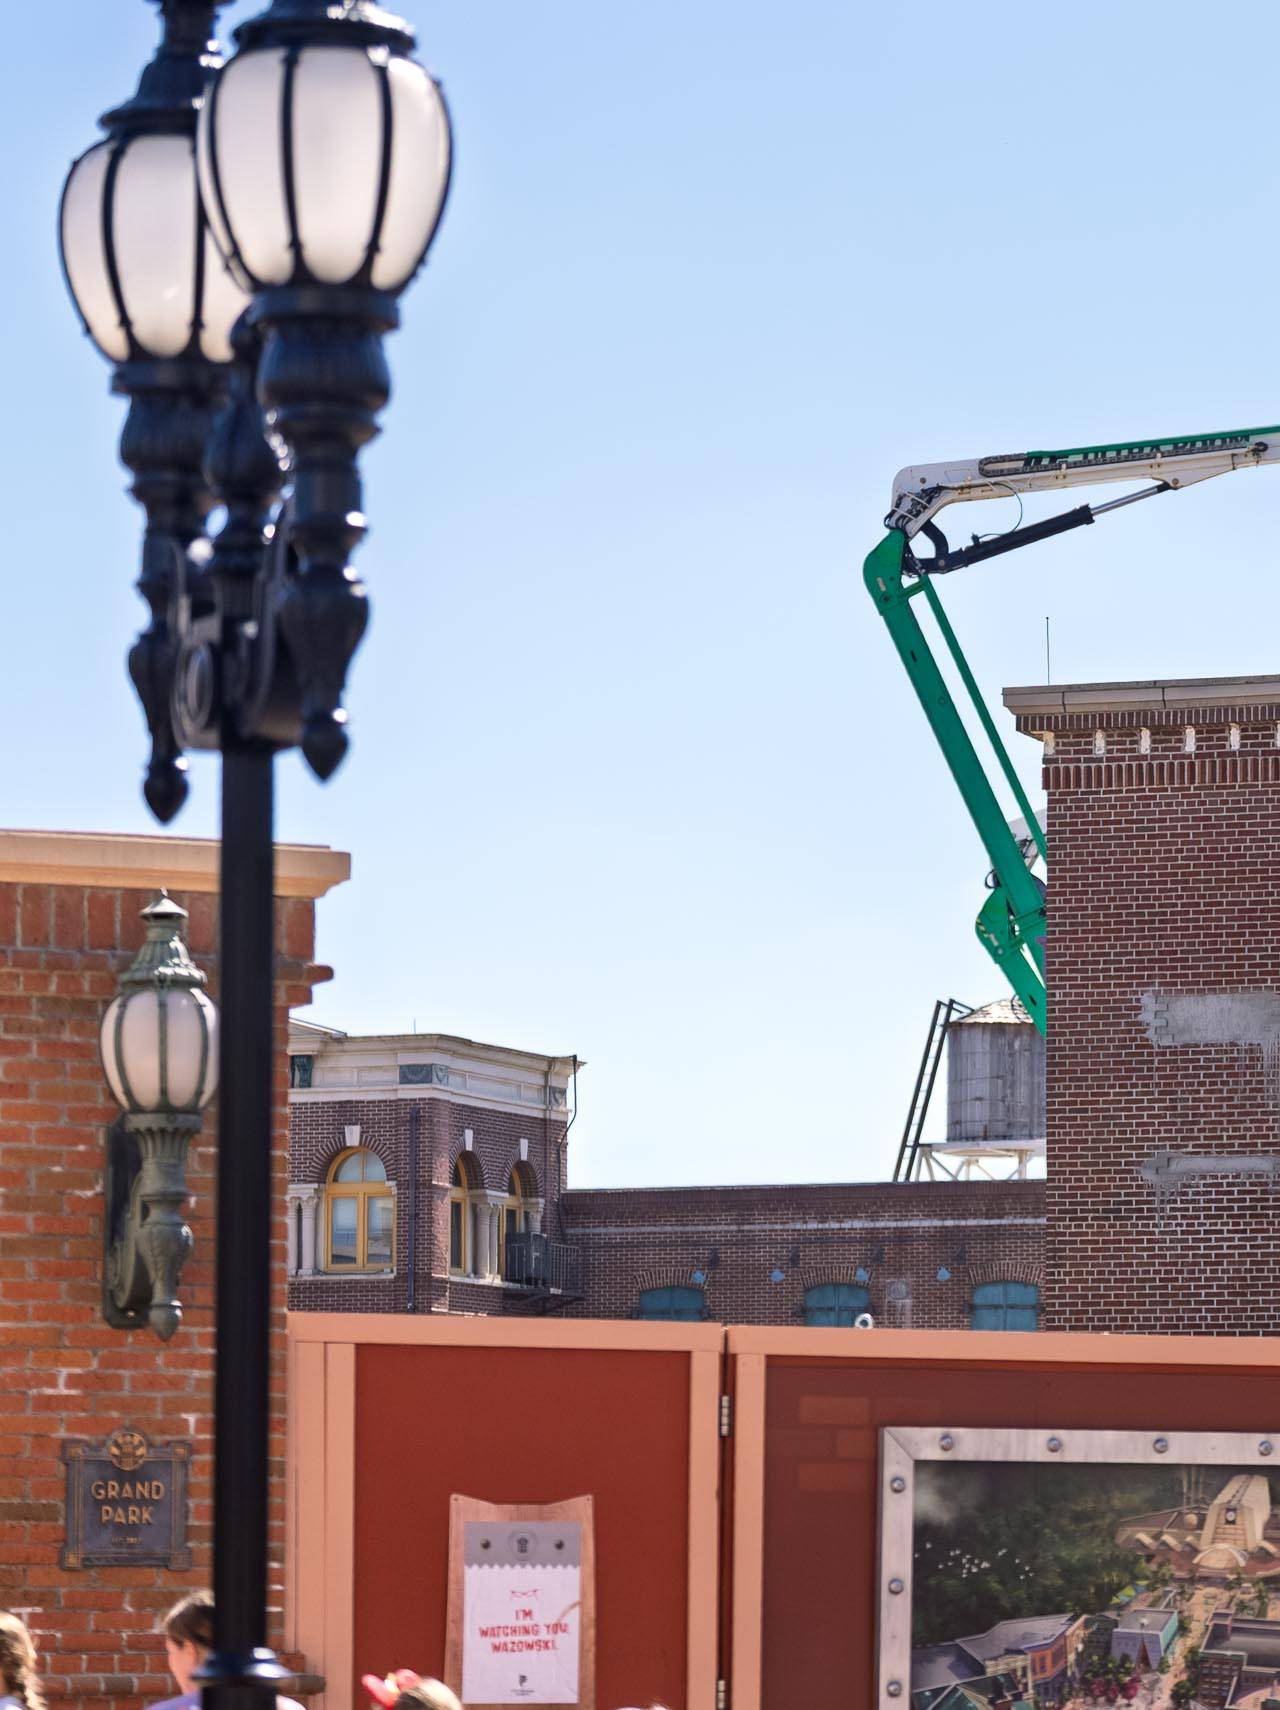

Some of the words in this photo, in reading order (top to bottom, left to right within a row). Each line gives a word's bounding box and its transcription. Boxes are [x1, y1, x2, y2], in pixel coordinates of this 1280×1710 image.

[91, 1480, 165, 1500] GRAND
[101, 1504, 154, 1525] PARK
[479, 1624, 540, 1638] WATCHING
